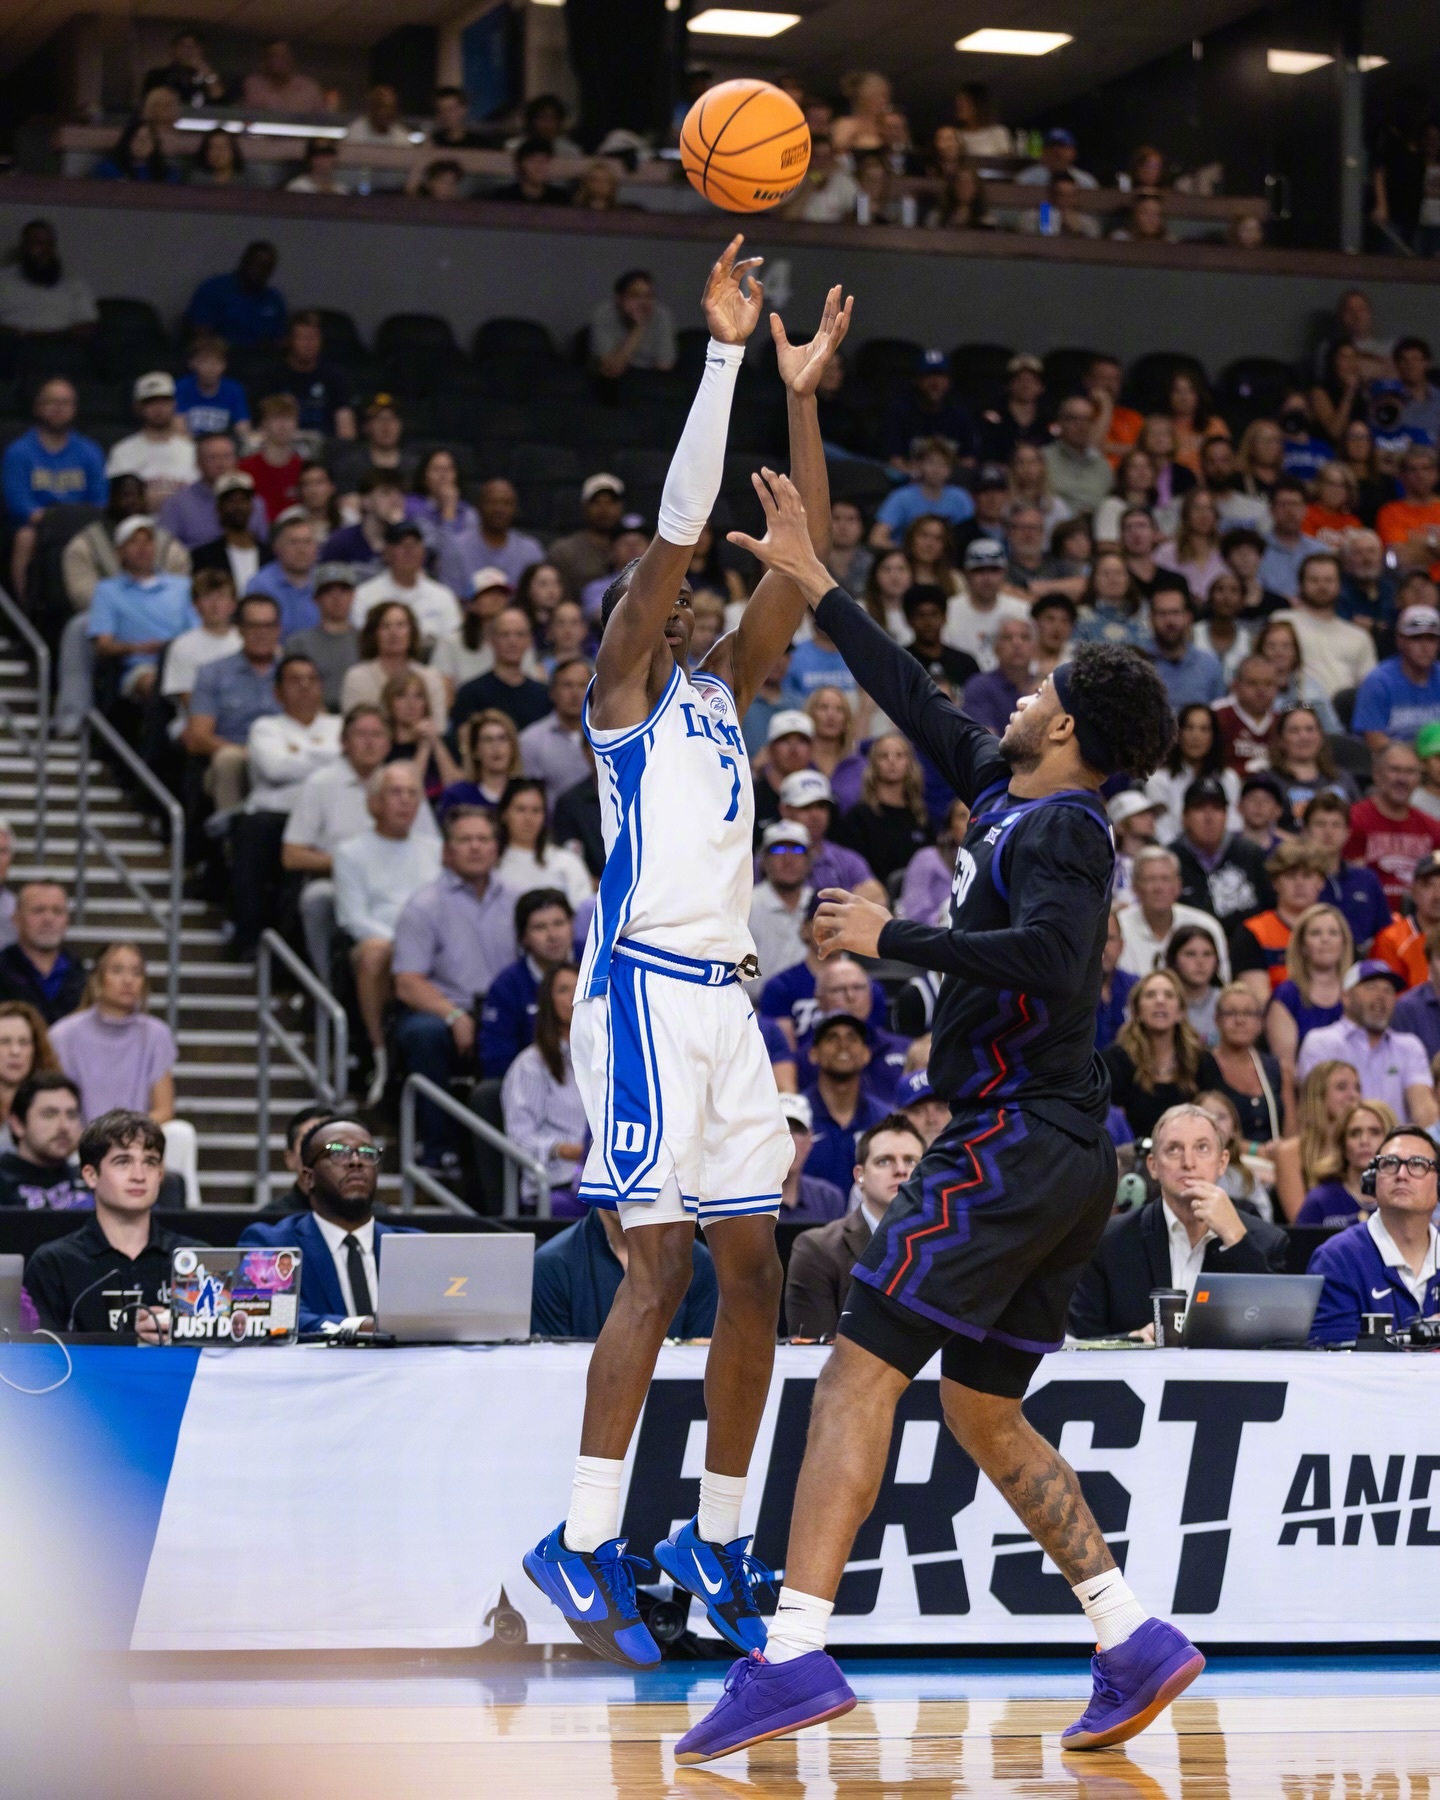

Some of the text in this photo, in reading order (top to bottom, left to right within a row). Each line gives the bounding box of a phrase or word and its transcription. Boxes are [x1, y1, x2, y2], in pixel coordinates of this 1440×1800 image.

[717, 752, 741, 822] 7
[707, 963, 726, 985] D
[613, 1120, 646, 1153] D
[443, 1277, 469, 1297] Z
[173, 1315, 217, 1338] JUST
